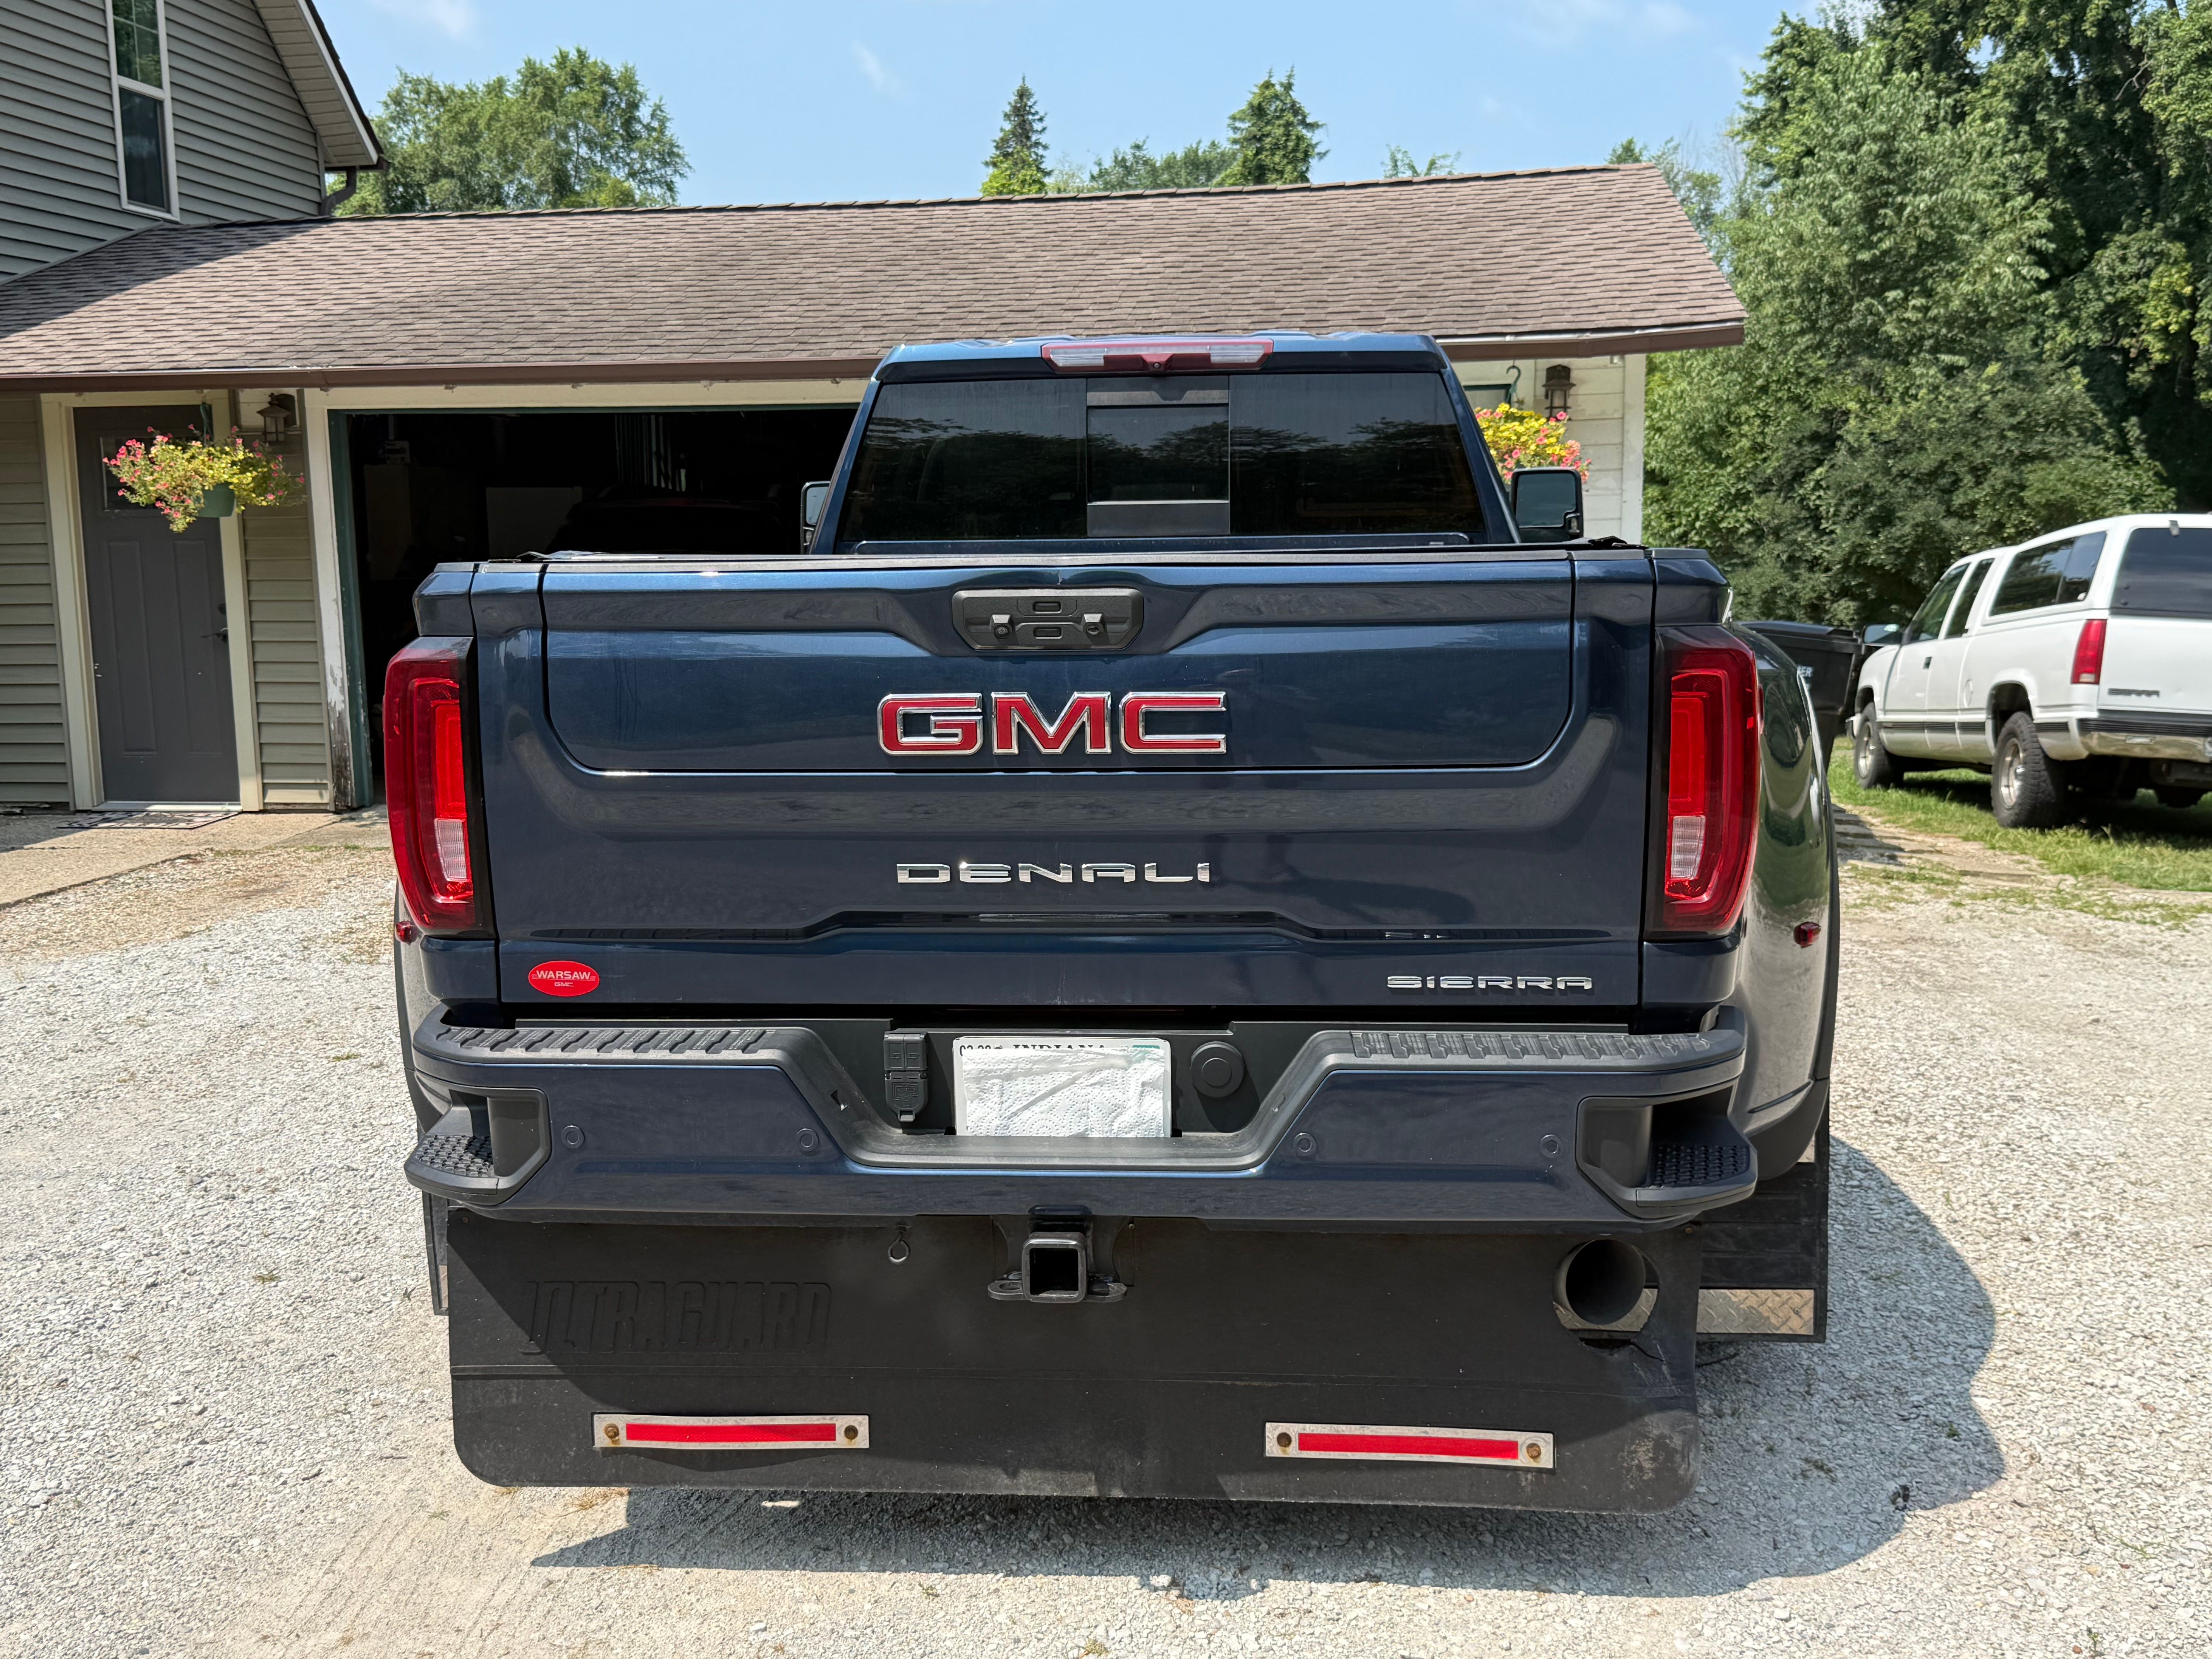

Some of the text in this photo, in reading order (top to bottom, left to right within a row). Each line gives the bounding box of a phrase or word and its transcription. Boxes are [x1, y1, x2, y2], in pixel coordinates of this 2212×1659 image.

[878, 691, 1227, 756] GMC
[896, 862, 1210, 884] DENALI
[536, 970, 591, 980] WARSAW
[1387, 975, 1592, 990] SIERRA
